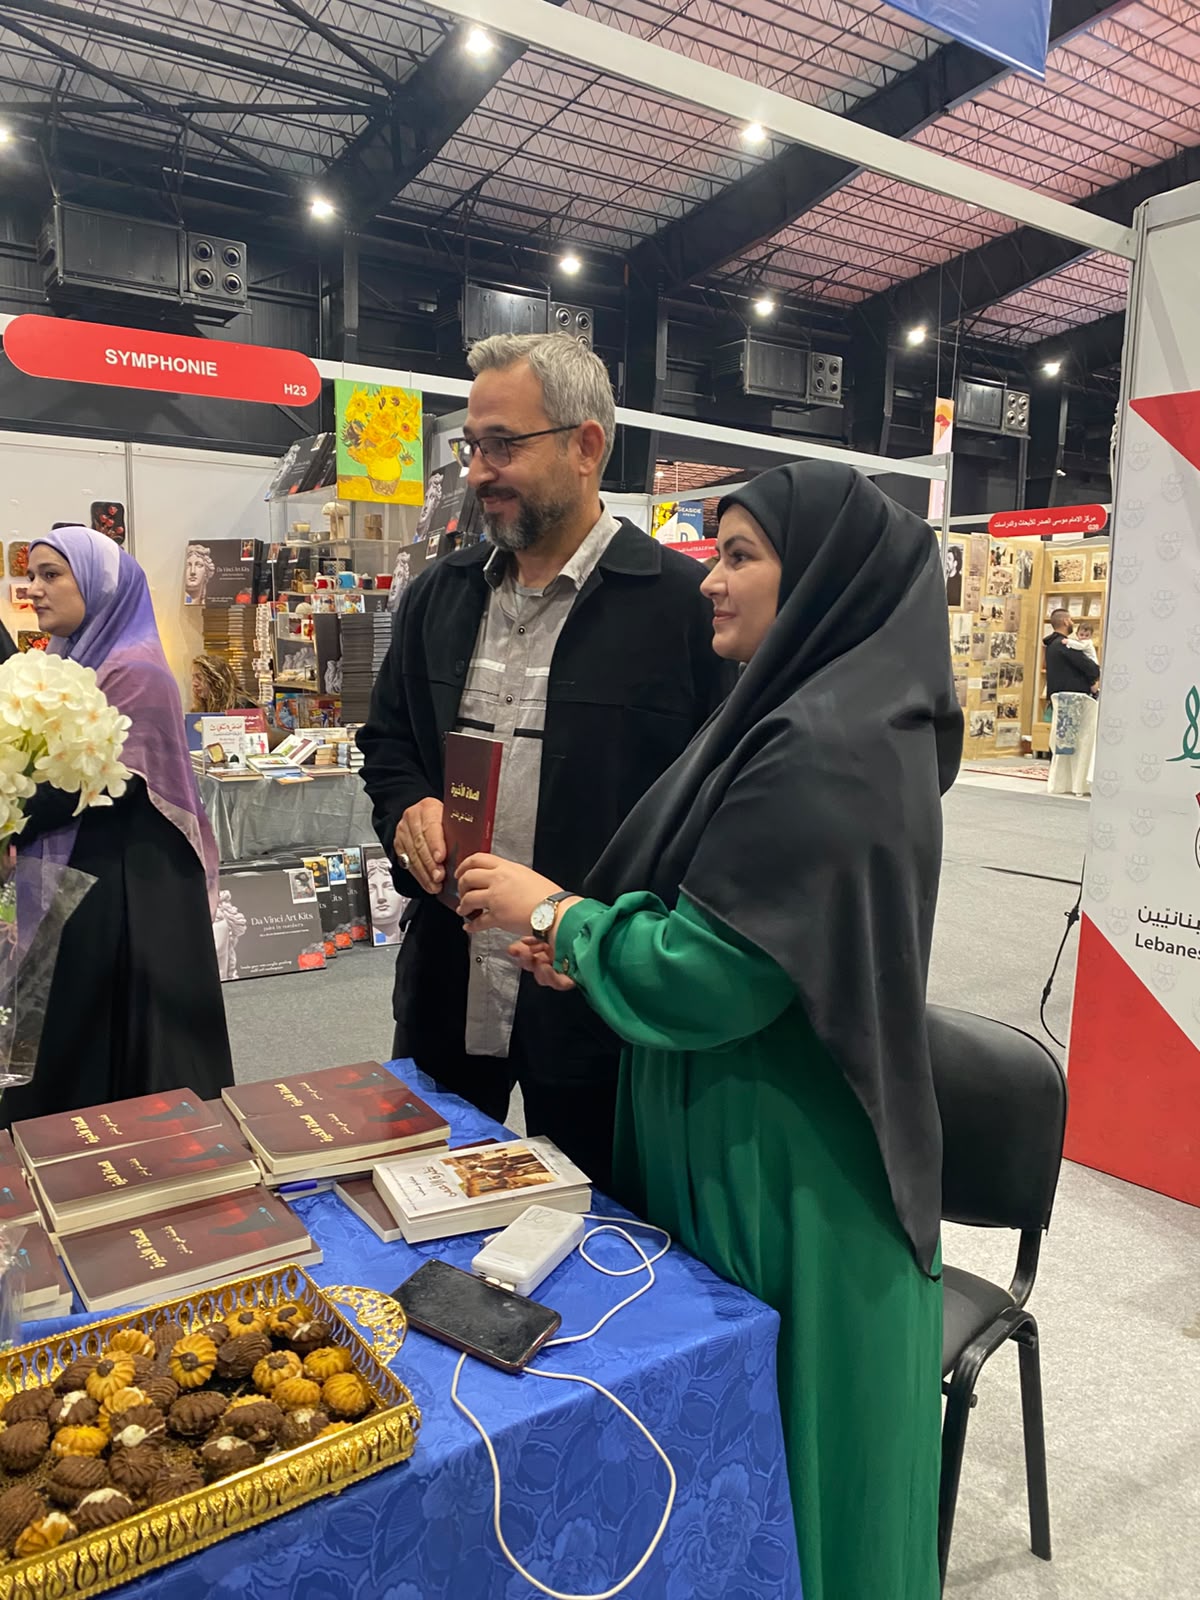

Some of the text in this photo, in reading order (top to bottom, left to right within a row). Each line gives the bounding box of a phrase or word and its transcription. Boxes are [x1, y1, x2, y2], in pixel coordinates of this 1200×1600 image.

[105, 349, 218, 376] SYMPHONIE
[284, 383, 307, 397] H23
[994, 520, 1018, 528] والدراسات
[1036, 518, 1052, 527] الصدر
[1083, 515, 1096, 524] مركز
[251, 912, 314, 926] Da Vinci Art Kits
[129, 1228, 152, 1249] الصلاة
